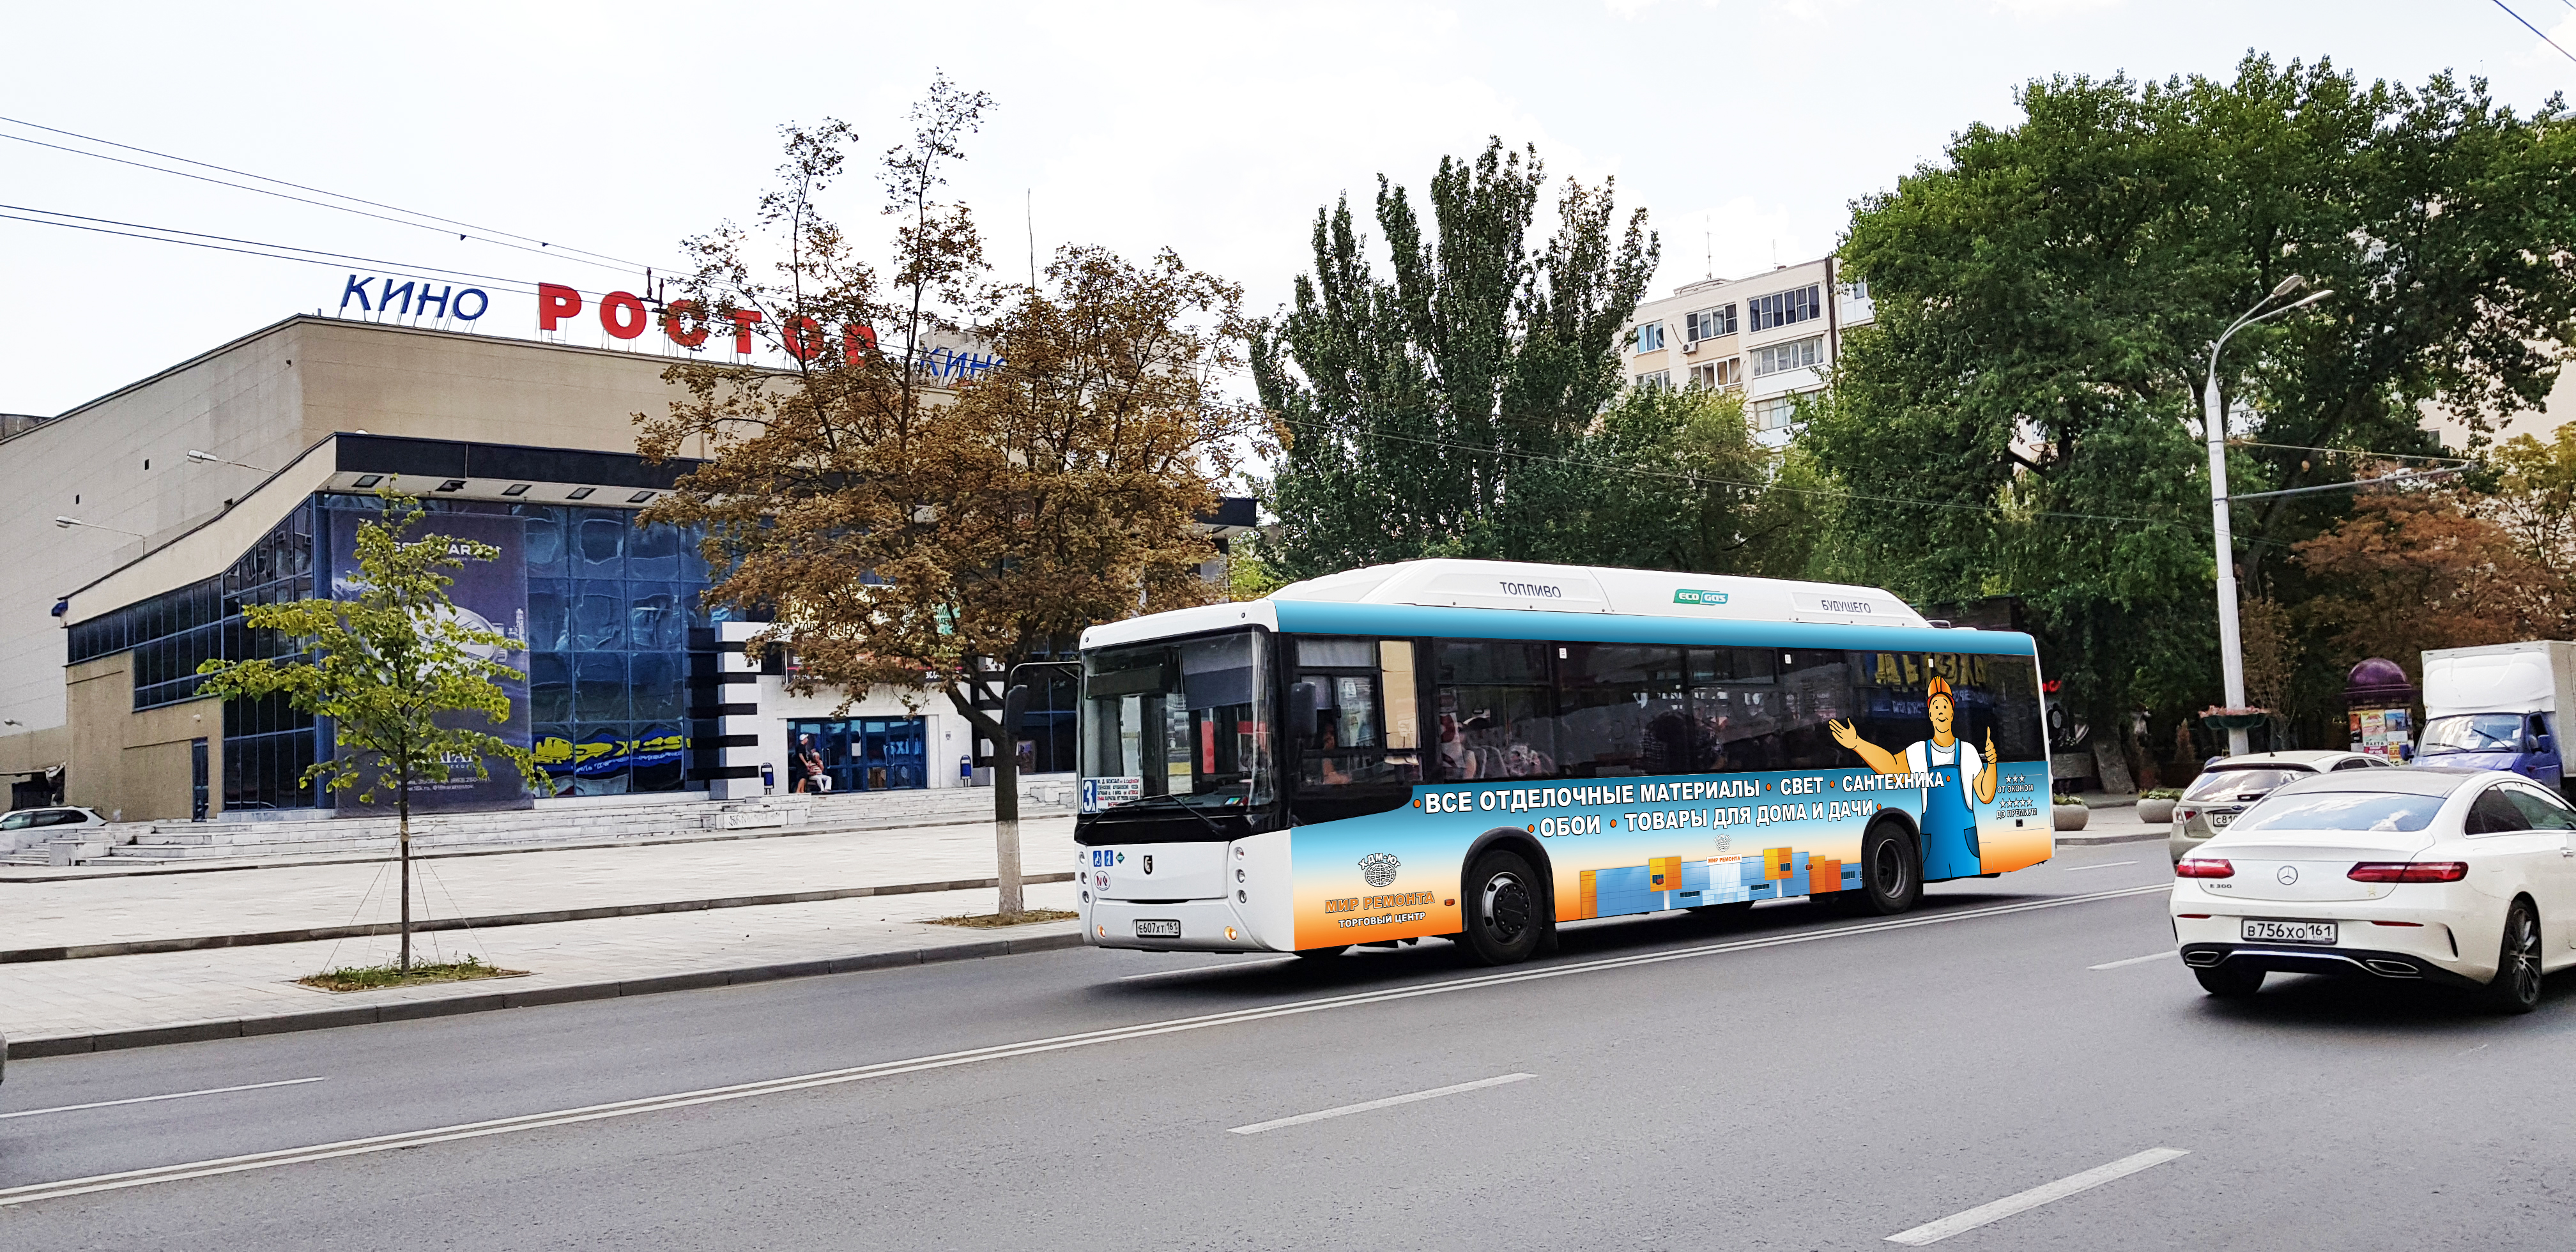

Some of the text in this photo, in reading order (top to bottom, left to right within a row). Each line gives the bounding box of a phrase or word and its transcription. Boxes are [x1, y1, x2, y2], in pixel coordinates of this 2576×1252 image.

[340, 274, 488, 321] КИНО
[1499, 582, 1561, 598] ТОПЛИВО
[1821, 599, 1871, 613] БУДУЩЕГО
[1425, 772, 1945, 814] ВСЕ ОТДЕЛОЧНЫЕ МАТЕРИАЛЫ СВЕТ САНТЕХНИКА
[1997, 784, 2034, 793] ОТ ЭКОНОМ
[1540, 799, 1873, 837] ОБОИ ТОВАРЫ ДЛЯ ДОМА И ДАЧИ
[1996, 807, 2037, 820] ДО ПРЕМИУМ
[1325, 890, 1435, 913] МИР РЕМОНТА
[1138, 922, 1178, 934] Е607ХТ 161
[1338, 912, 1426, 928] ТОРГОВЫЙ ЦЕНТР
[2247, 922, 2331, 939] В756ХО 161
